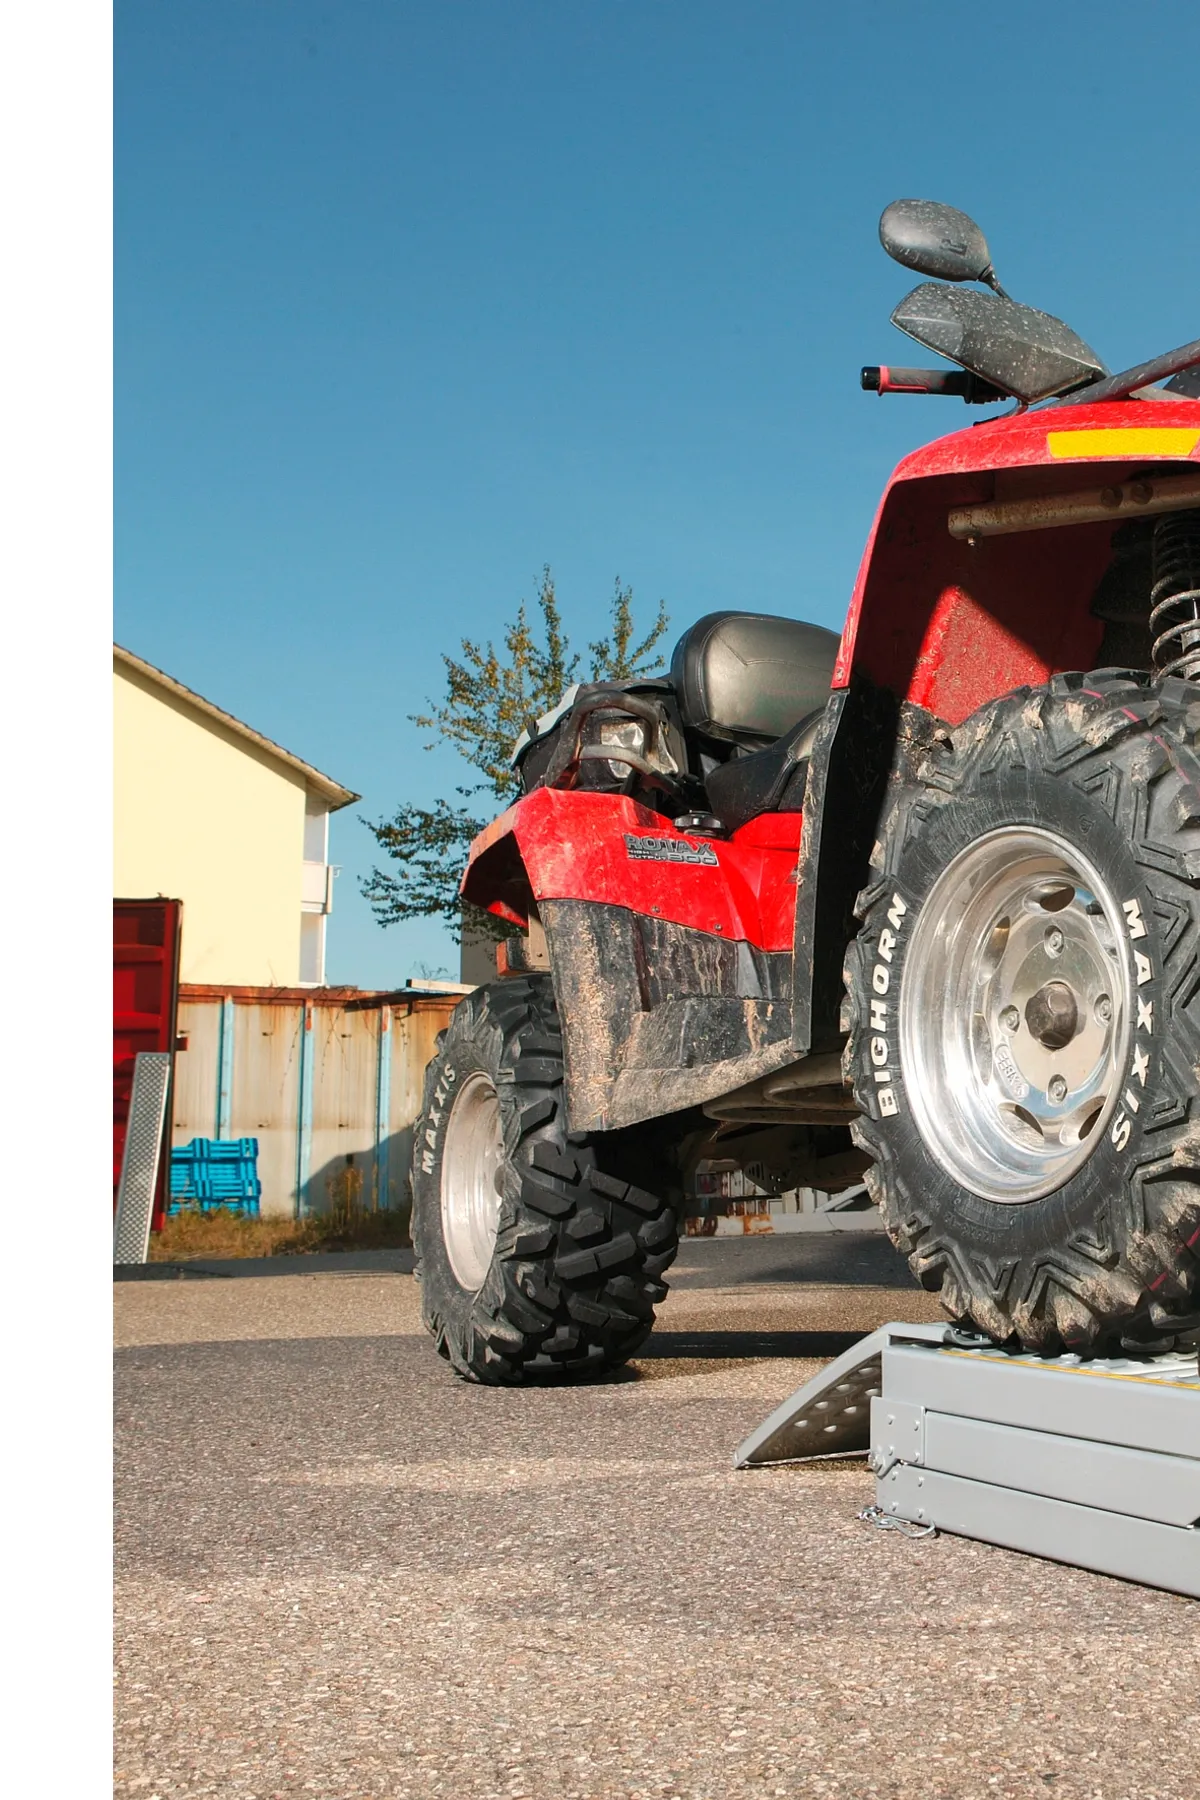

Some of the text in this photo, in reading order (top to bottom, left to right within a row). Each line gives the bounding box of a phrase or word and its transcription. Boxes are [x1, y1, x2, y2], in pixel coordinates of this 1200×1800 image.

[622, 833, 716, 856] ROTAX
[870, 892, 908, 1118] BIGHORN
[1111, 898, 1154, 1152] MAXXIS
[421, 1063, 456, 1175] MAXXIS
